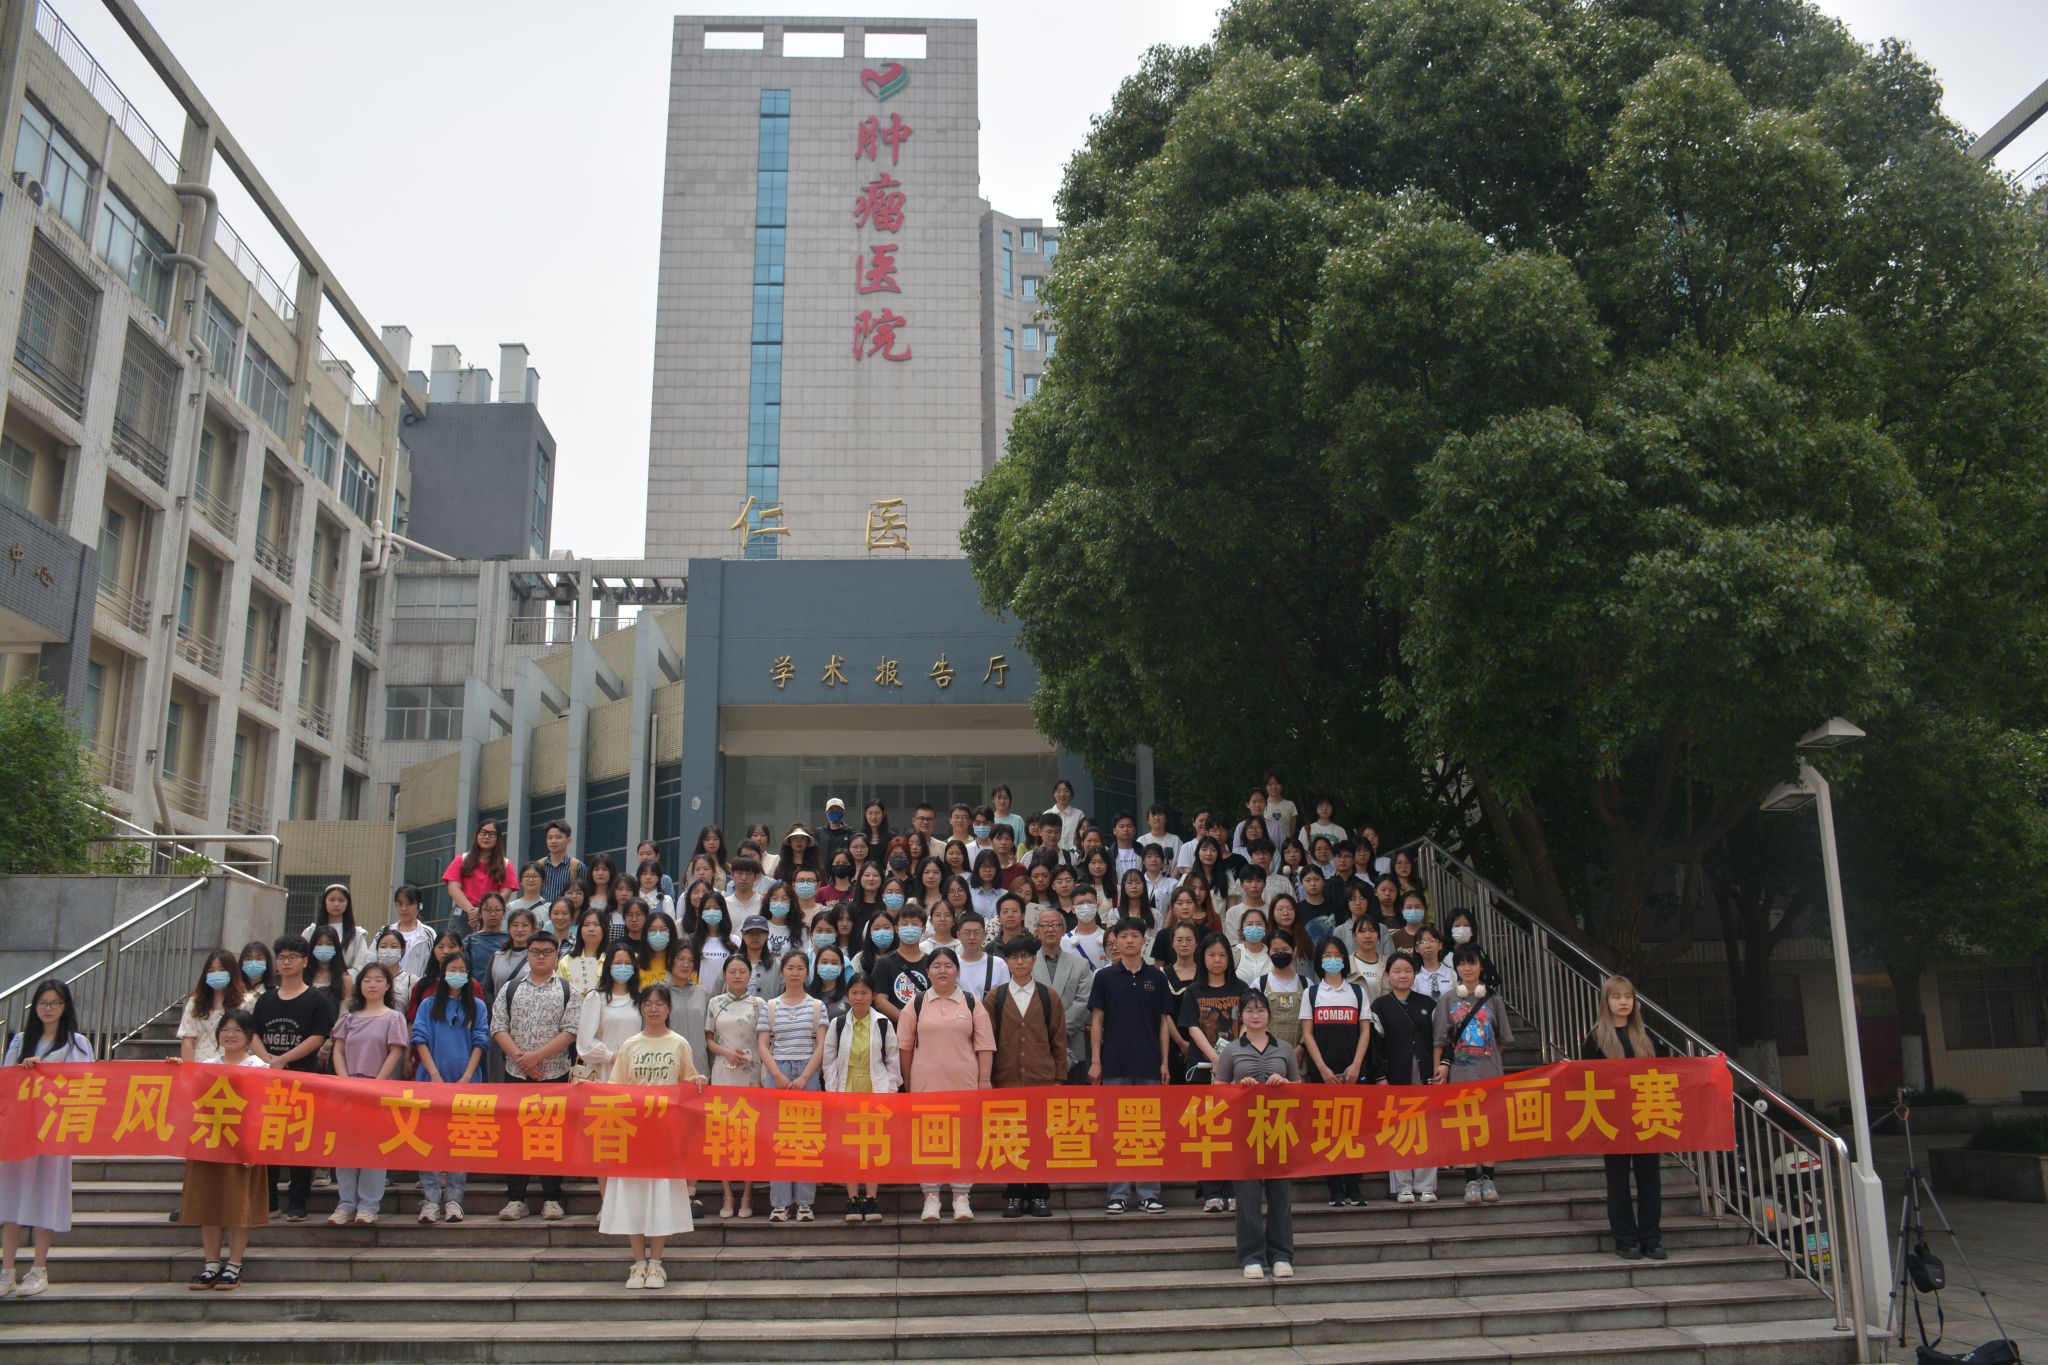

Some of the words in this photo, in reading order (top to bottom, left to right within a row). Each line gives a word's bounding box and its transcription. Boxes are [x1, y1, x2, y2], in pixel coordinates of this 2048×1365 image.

[853, 112, 912, 362] 肿瘤医院
[769, 652, 1009, 689] 学术报告厅
[1317, 1009, 1354, 1021] COMBAT
[263, 1033, 302, 1046] ANGELUS
